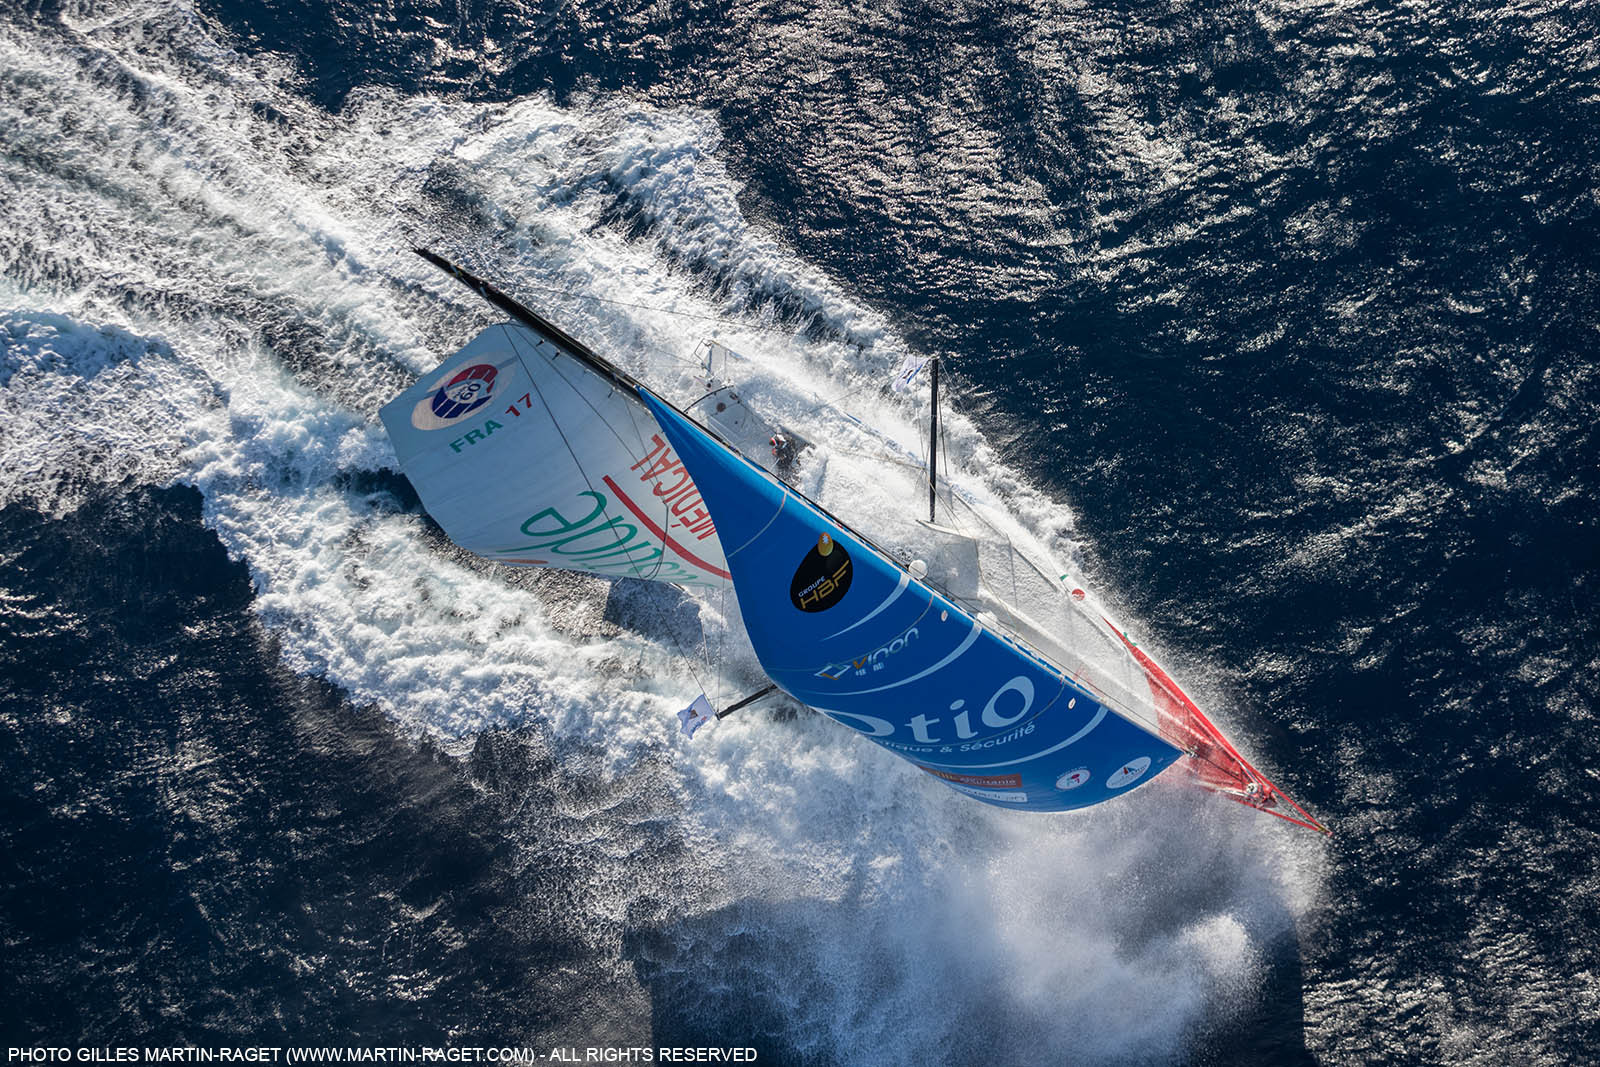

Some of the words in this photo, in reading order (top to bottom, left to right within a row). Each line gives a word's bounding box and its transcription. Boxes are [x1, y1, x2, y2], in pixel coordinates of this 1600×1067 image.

[460, 383, 481, 401] 60
[449, 420, 503, 453] FRA
[505, 392, 532, 417] 17
[798, 575, 826, 598] GROUPE
[800, 559, 850, 609] HBF
[960, 719, 1035, 752] Sécurité
